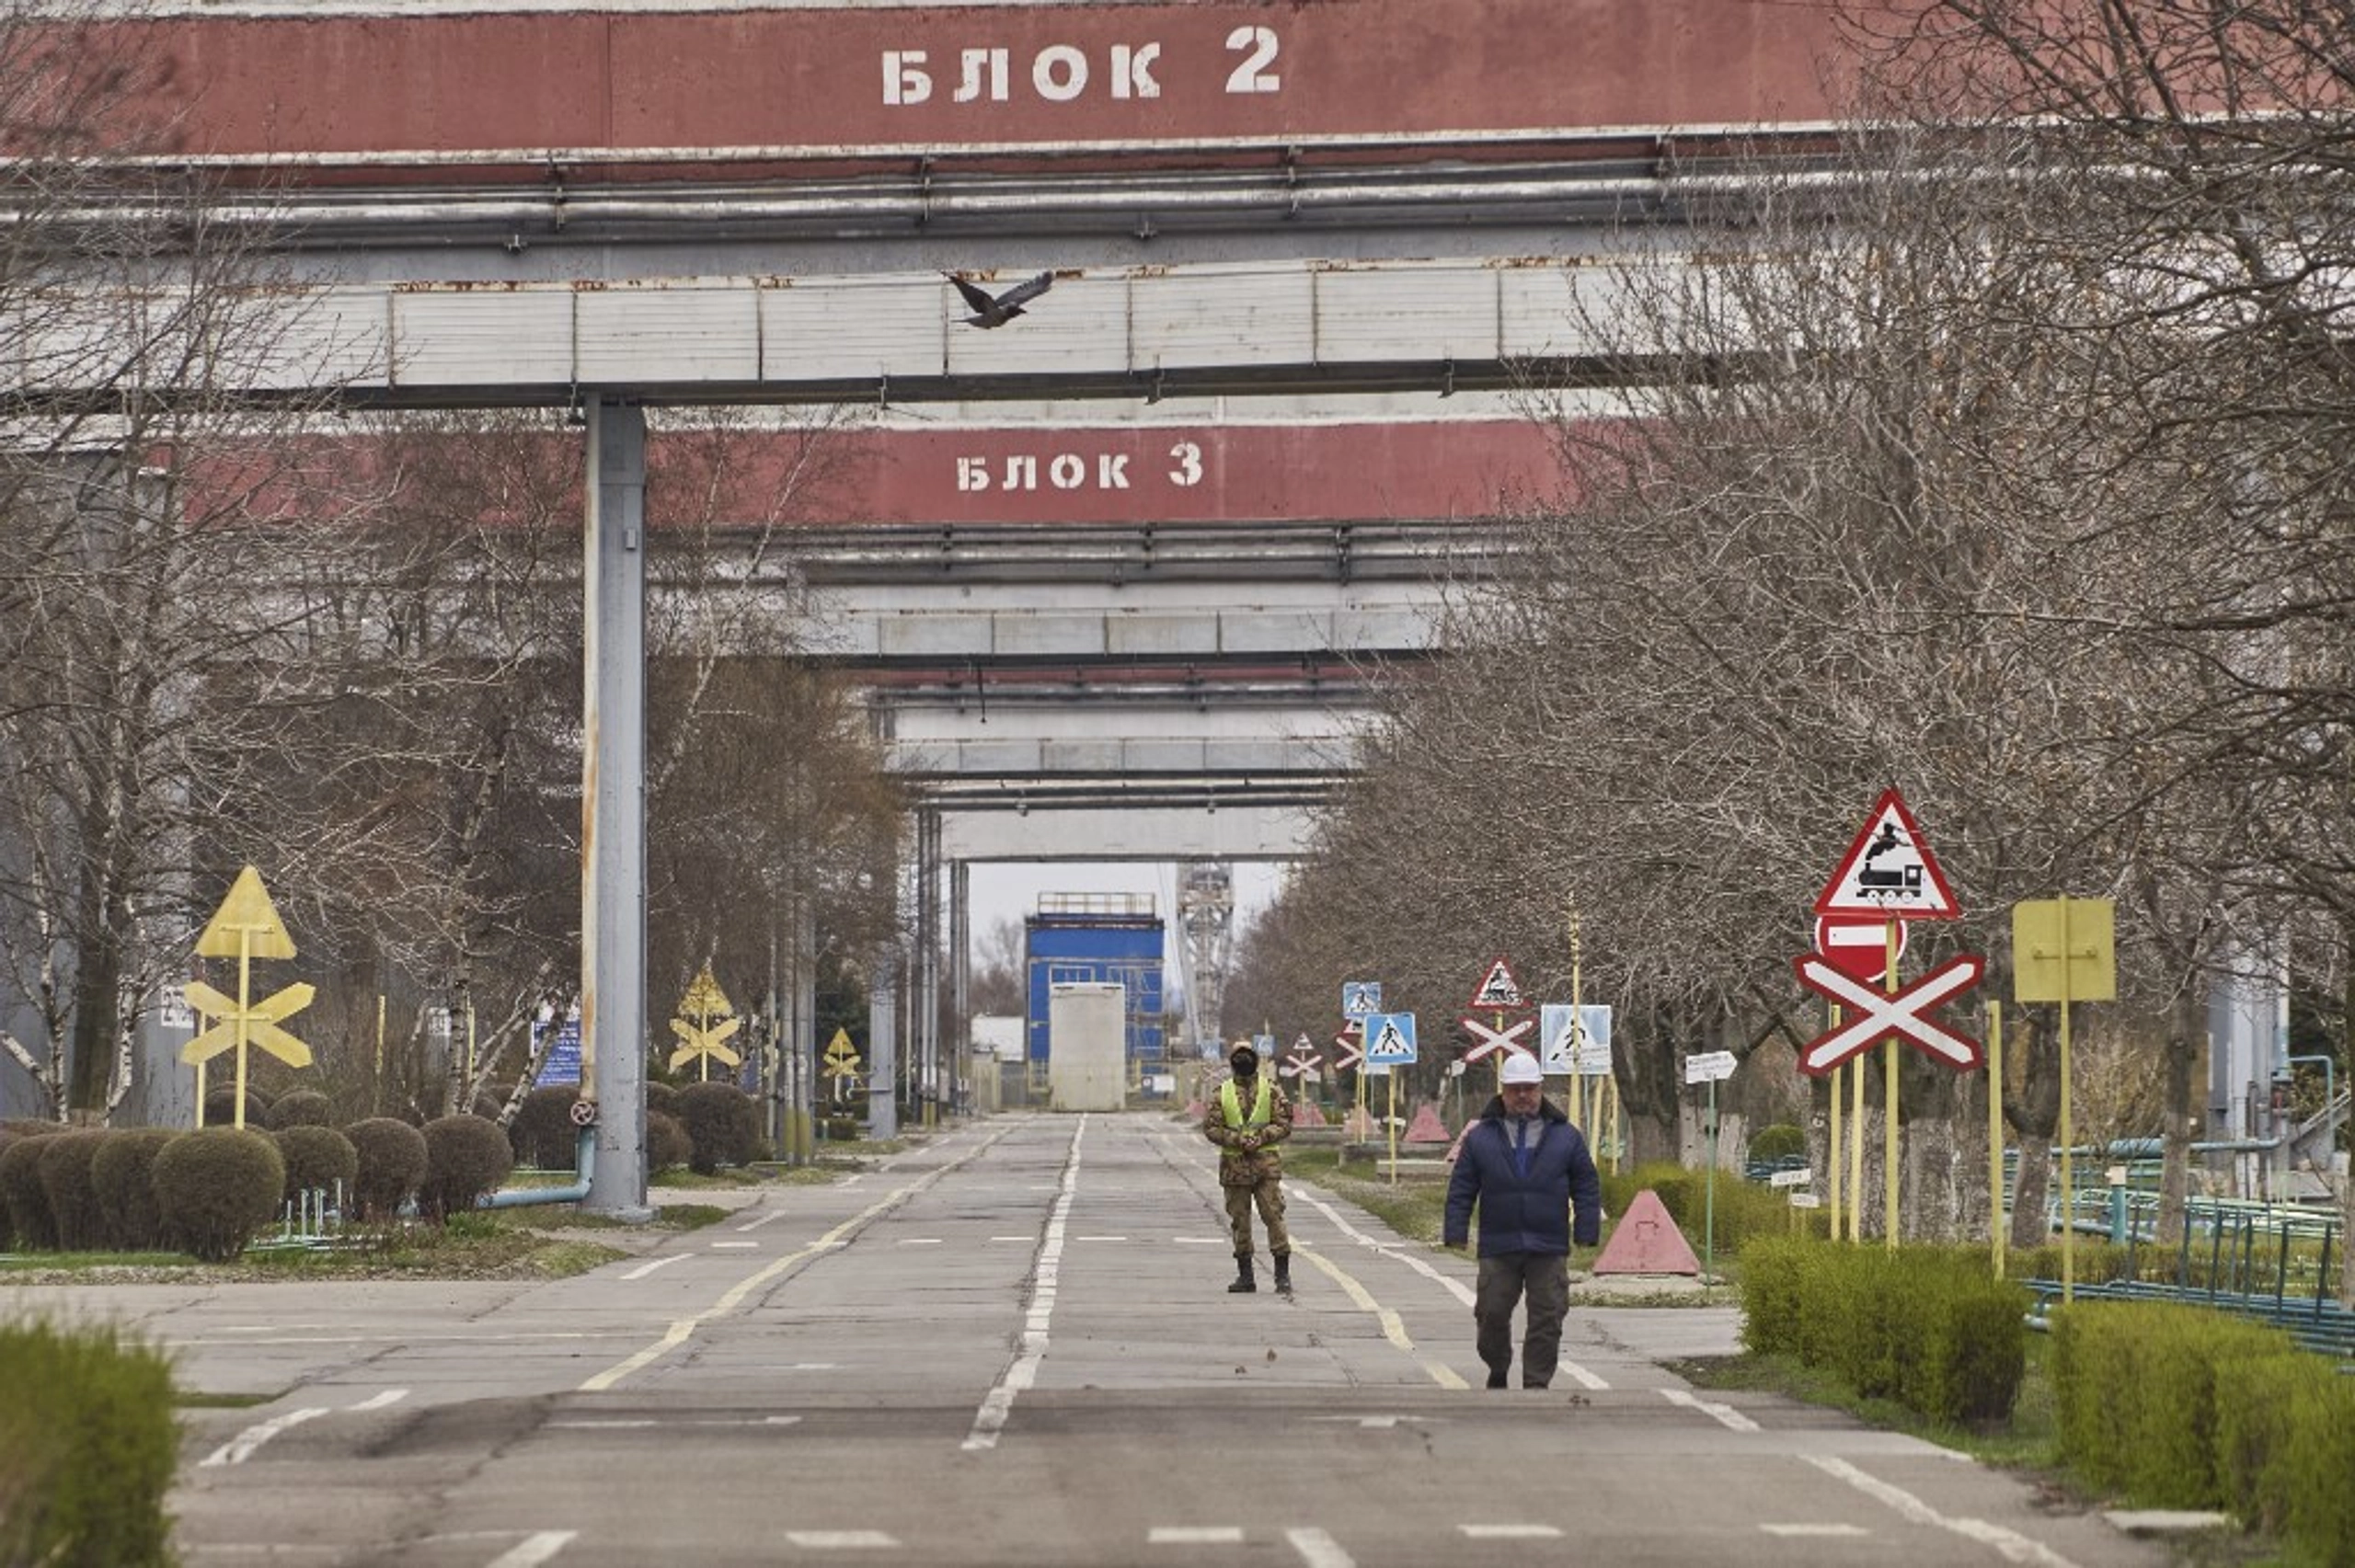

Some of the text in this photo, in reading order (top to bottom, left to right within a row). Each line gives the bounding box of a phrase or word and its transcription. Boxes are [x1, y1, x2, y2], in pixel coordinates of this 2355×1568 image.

[883, 27, 1279, 104] БЛОК 2
[958, 443, 1202, 490] БЛОК 3
